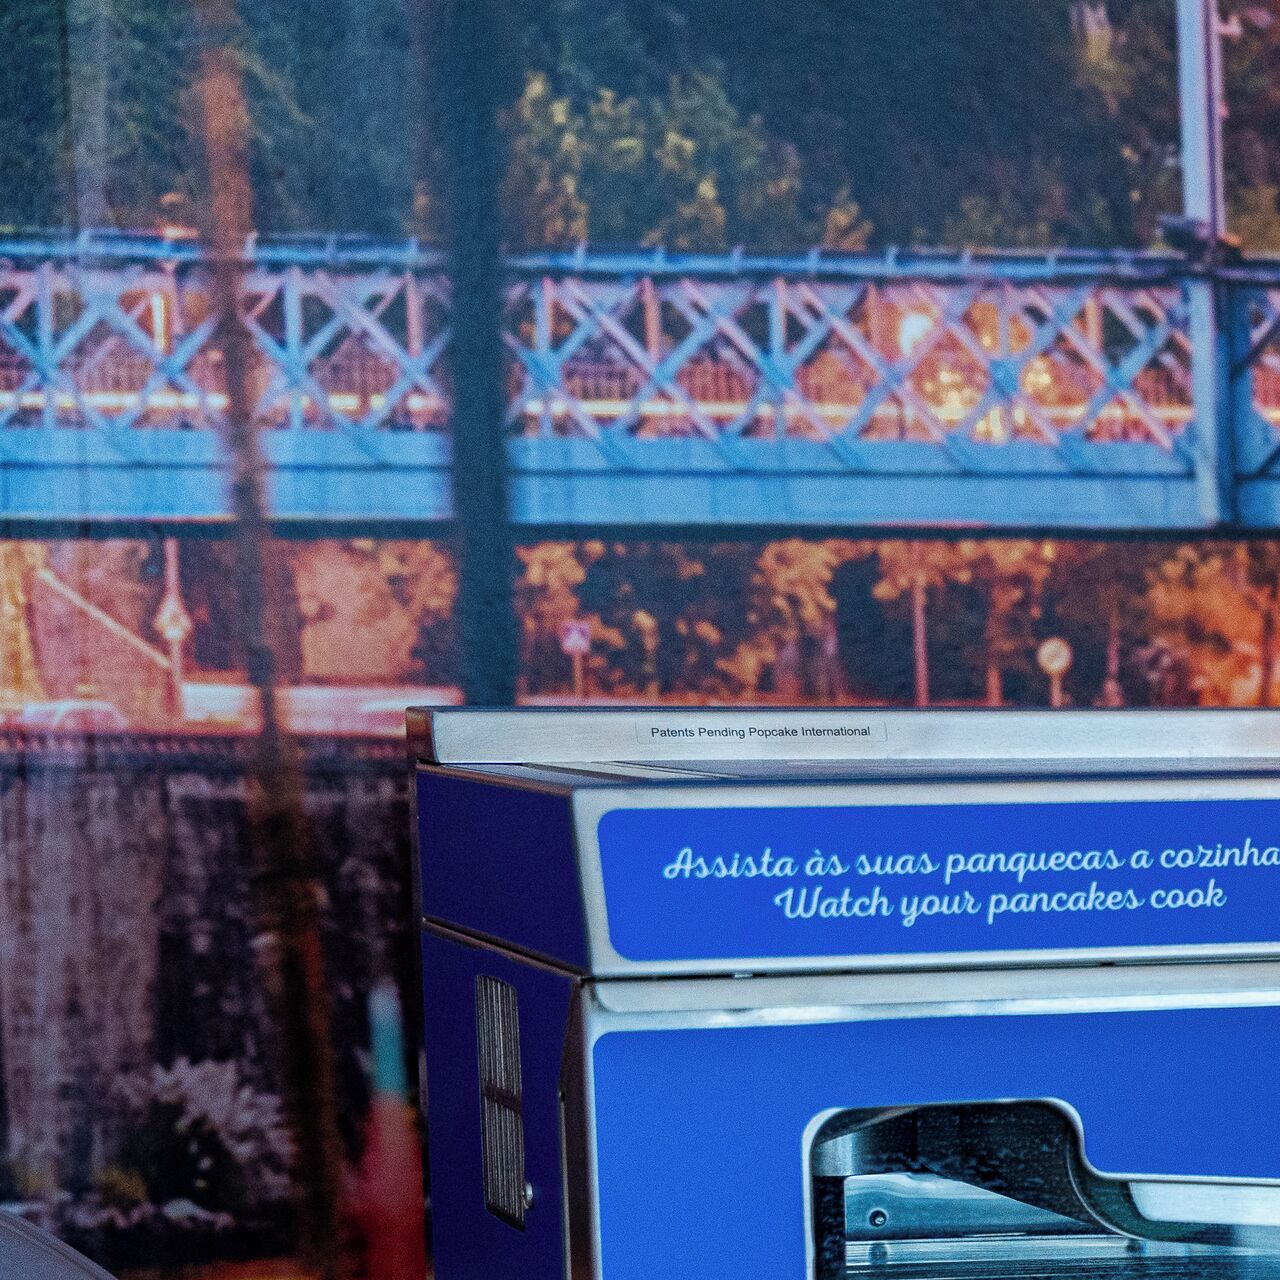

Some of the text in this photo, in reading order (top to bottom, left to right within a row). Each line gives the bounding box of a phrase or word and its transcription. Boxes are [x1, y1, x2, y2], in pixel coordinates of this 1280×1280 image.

[651, 727, 871, 739] Patents Pending Popcake International
[663, 847, 798, 879] Assista
[805, 849, 850, 876] às
[856, 853, 940, 875] suas
[944, 849, 1126, 884] panquecas
[1130, 850, 1154, 869] a
[774, 879, 1227, 927] Watch your pancakes cook
